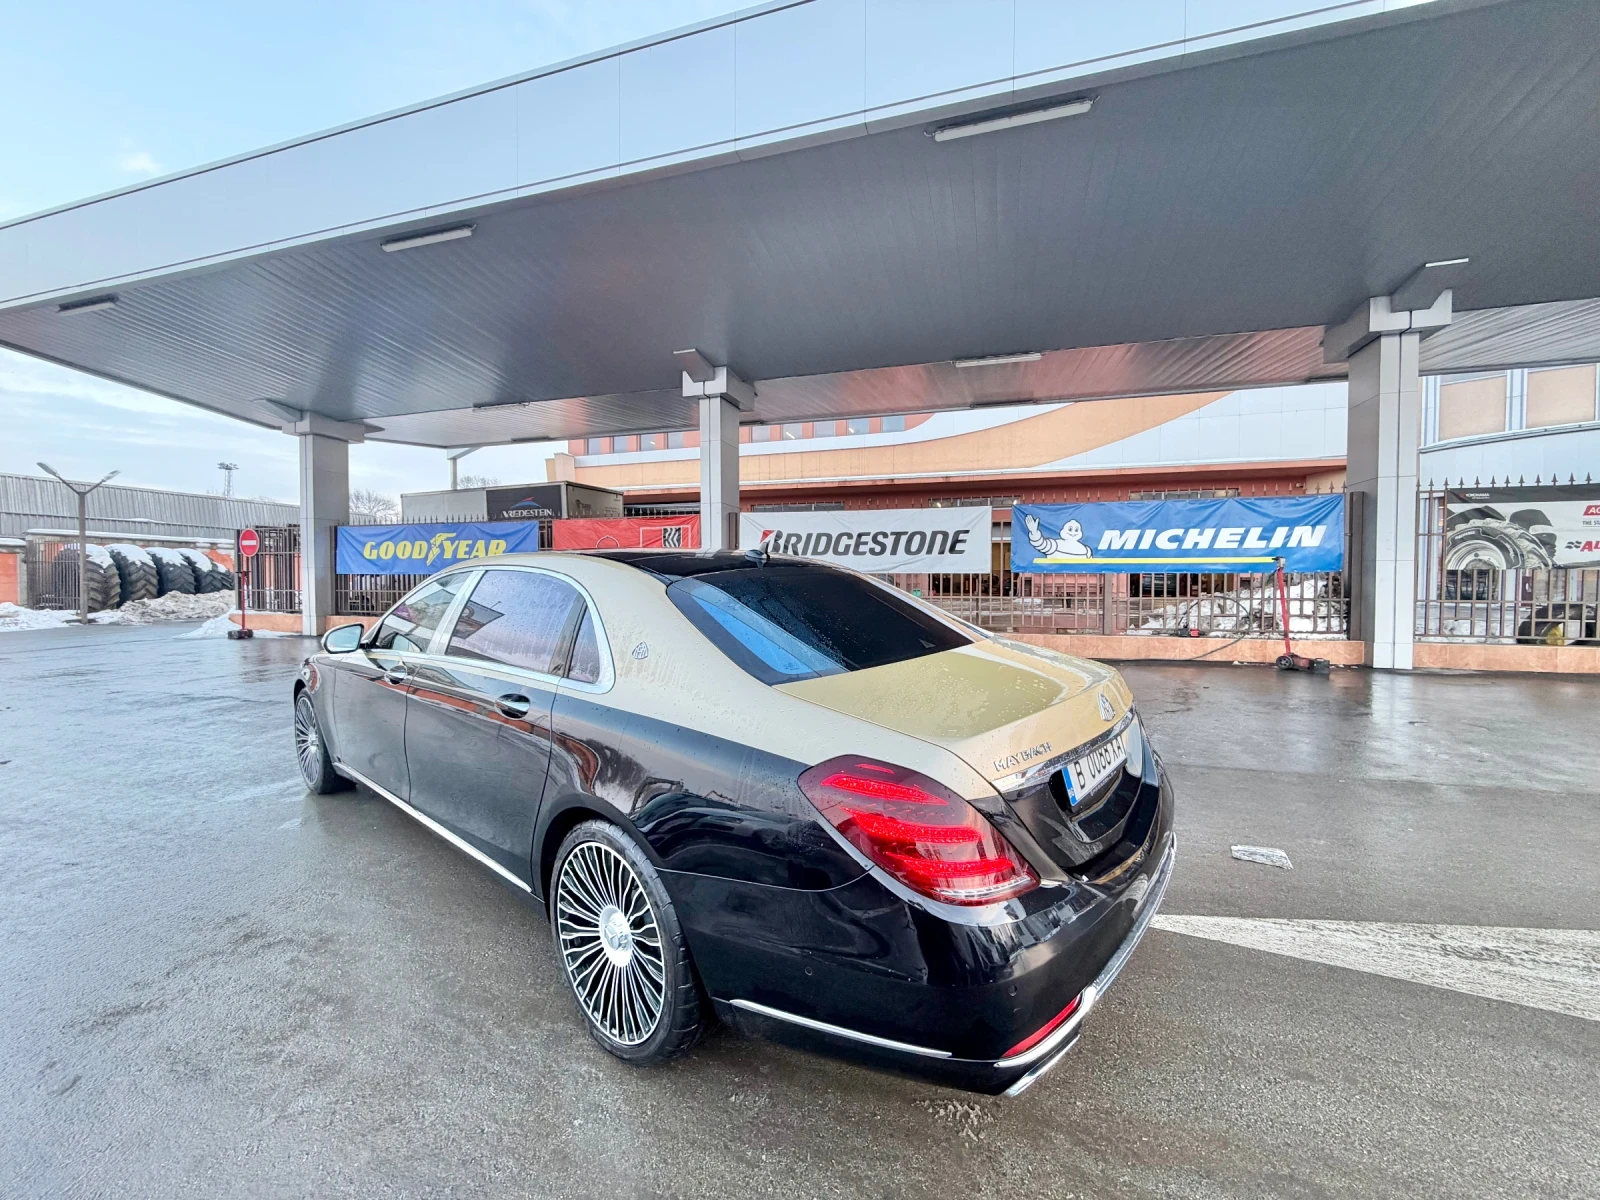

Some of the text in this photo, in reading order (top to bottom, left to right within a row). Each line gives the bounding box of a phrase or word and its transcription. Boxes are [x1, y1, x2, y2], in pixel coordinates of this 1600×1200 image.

[760, 529, 971, 557] BRIDGESTONE
[1097, 525, 1328, 549] MICHELIN
[993, 741, 1053, 773] MAYBACH
[1073, 760, 1086, 790] B
